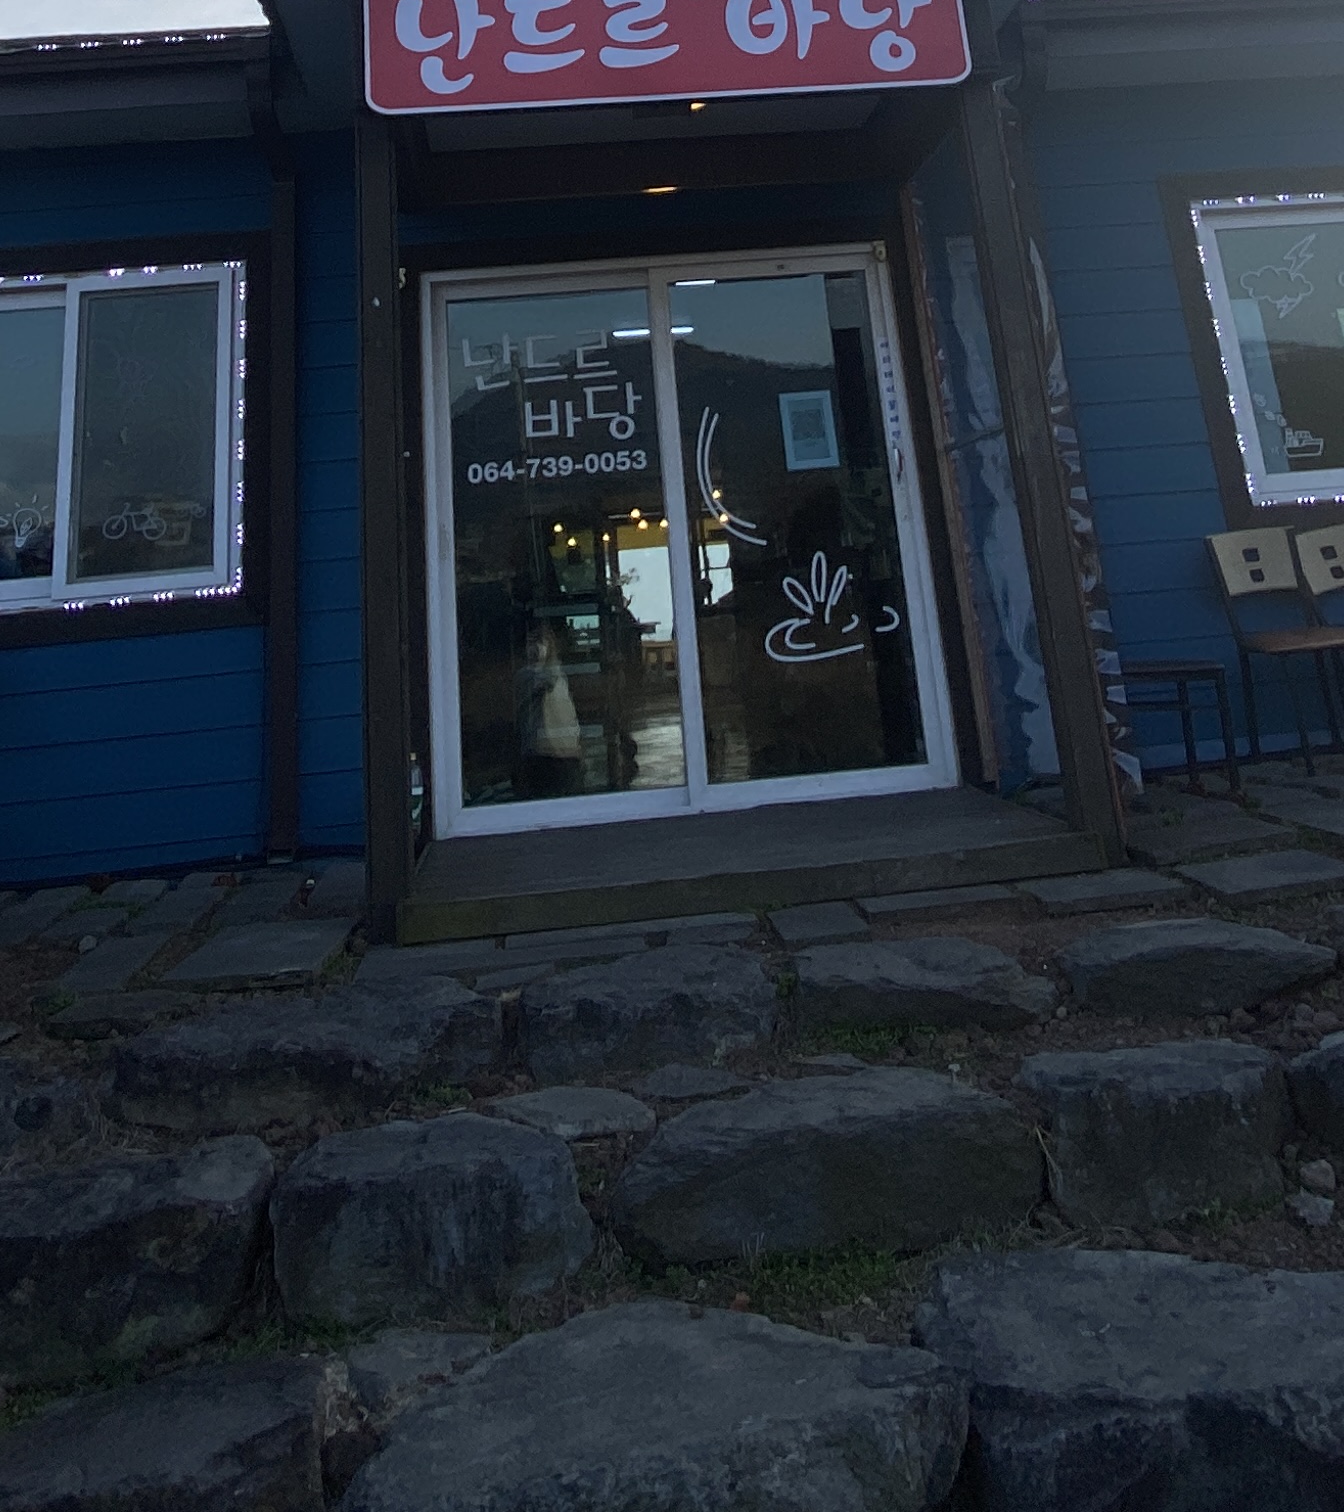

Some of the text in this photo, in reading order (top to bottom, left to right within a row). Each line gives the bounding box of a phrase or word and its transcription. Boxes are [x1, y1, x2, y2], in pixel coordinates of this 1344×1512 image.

[461, 329, 618, 391] 난드르
[524, 381, 643, 441] 바당
[467, 448, 648, 485] 064-739-0053
